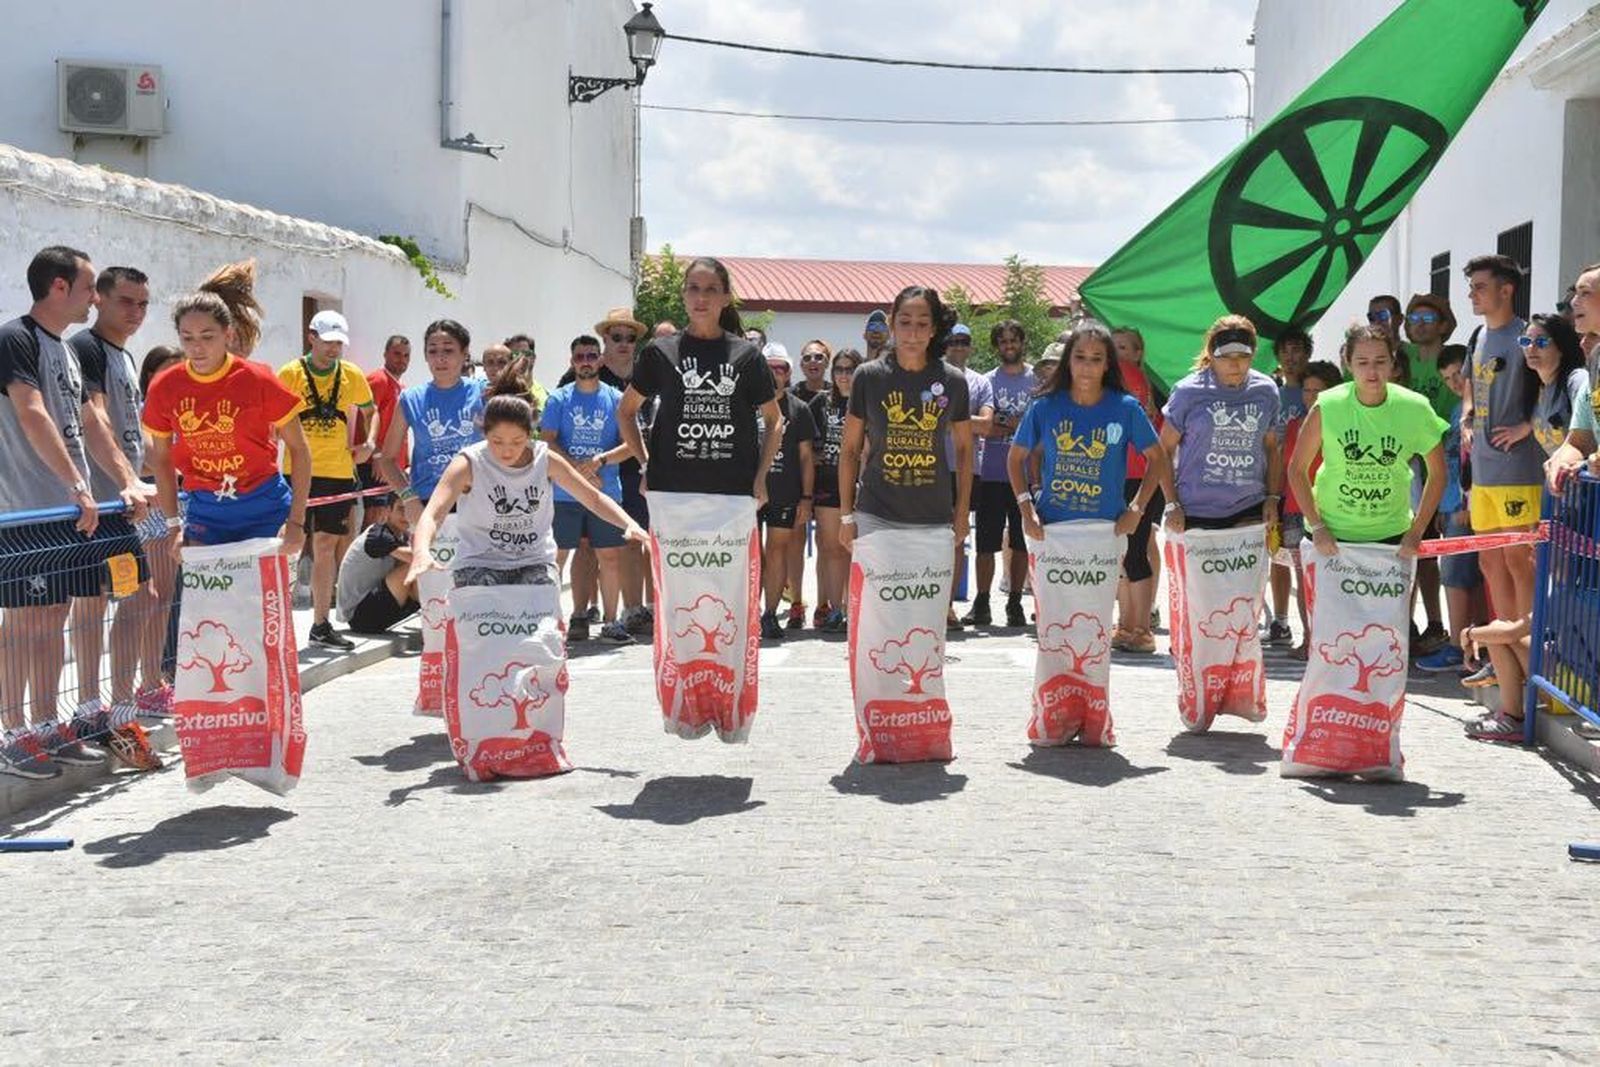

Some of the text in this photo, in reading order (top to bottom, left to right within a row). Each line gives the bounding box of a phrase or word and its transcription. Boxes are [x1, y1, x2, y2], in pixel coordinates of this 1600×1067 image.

[683, 403, 731, 414] RURALES
[677, 423, 735, 439] COVAP
[887, 436, 933, 448] RURALES
[192, 454, 244, 473] COVAP
[883, 453, 936, 468] COVAP
[1206, 452, 1254, 468] COVAP
[1055, 463, 1101, 477] RURALES
[1051, 479, 1103, 497] COVAP
[1339, 484, 1391, 500] COVAP
[489, 530, 539, 545] COVAP
[666, 551, 733, 568] COVAP
[1201, 554, 1257, 574] COVAP
[1046, 569, 1107, 586] COVAP
[879, 583, 940, 601] COVAP
[1341, 578, 1405, 598] COVAP
[265, 589, 280, 647] COVAP
[477, 621, 538, 637] COVAP
[745, 635, 758, 686] COVAP
[869, 705, 951, 728] Extensivo
[1310, 705, 1390, 733] Extensivo
